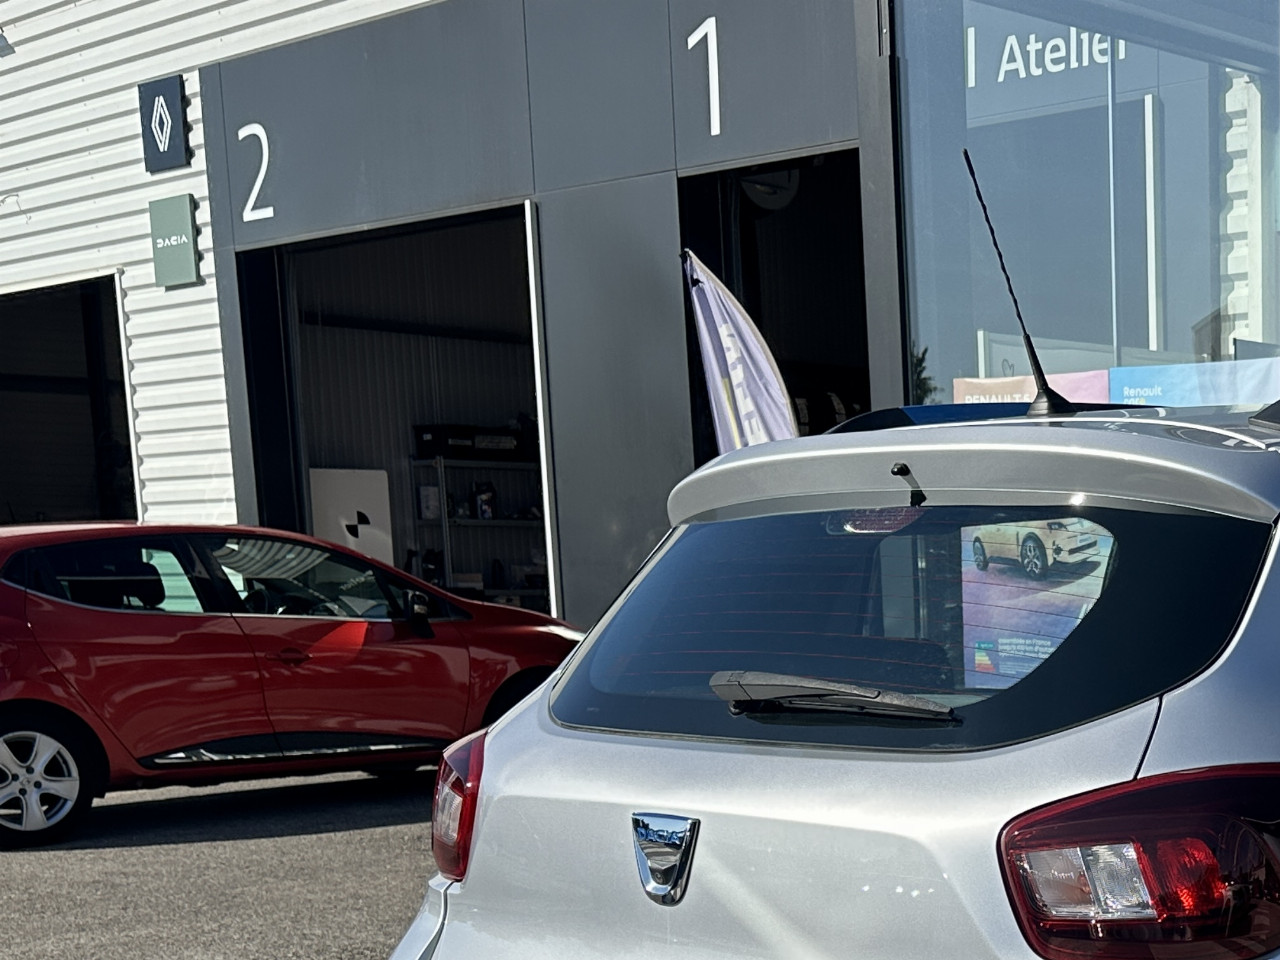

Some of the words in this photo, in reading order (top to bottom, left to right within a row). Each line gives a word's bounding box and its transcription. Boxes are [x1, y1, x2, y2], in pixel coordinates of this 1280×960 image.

[685, 15, 724, 138] 1
[236, 122, 275, 222] 2
[156, 234, 188, 248] DACIA
[1123, 384, 1162, 397] Renault
